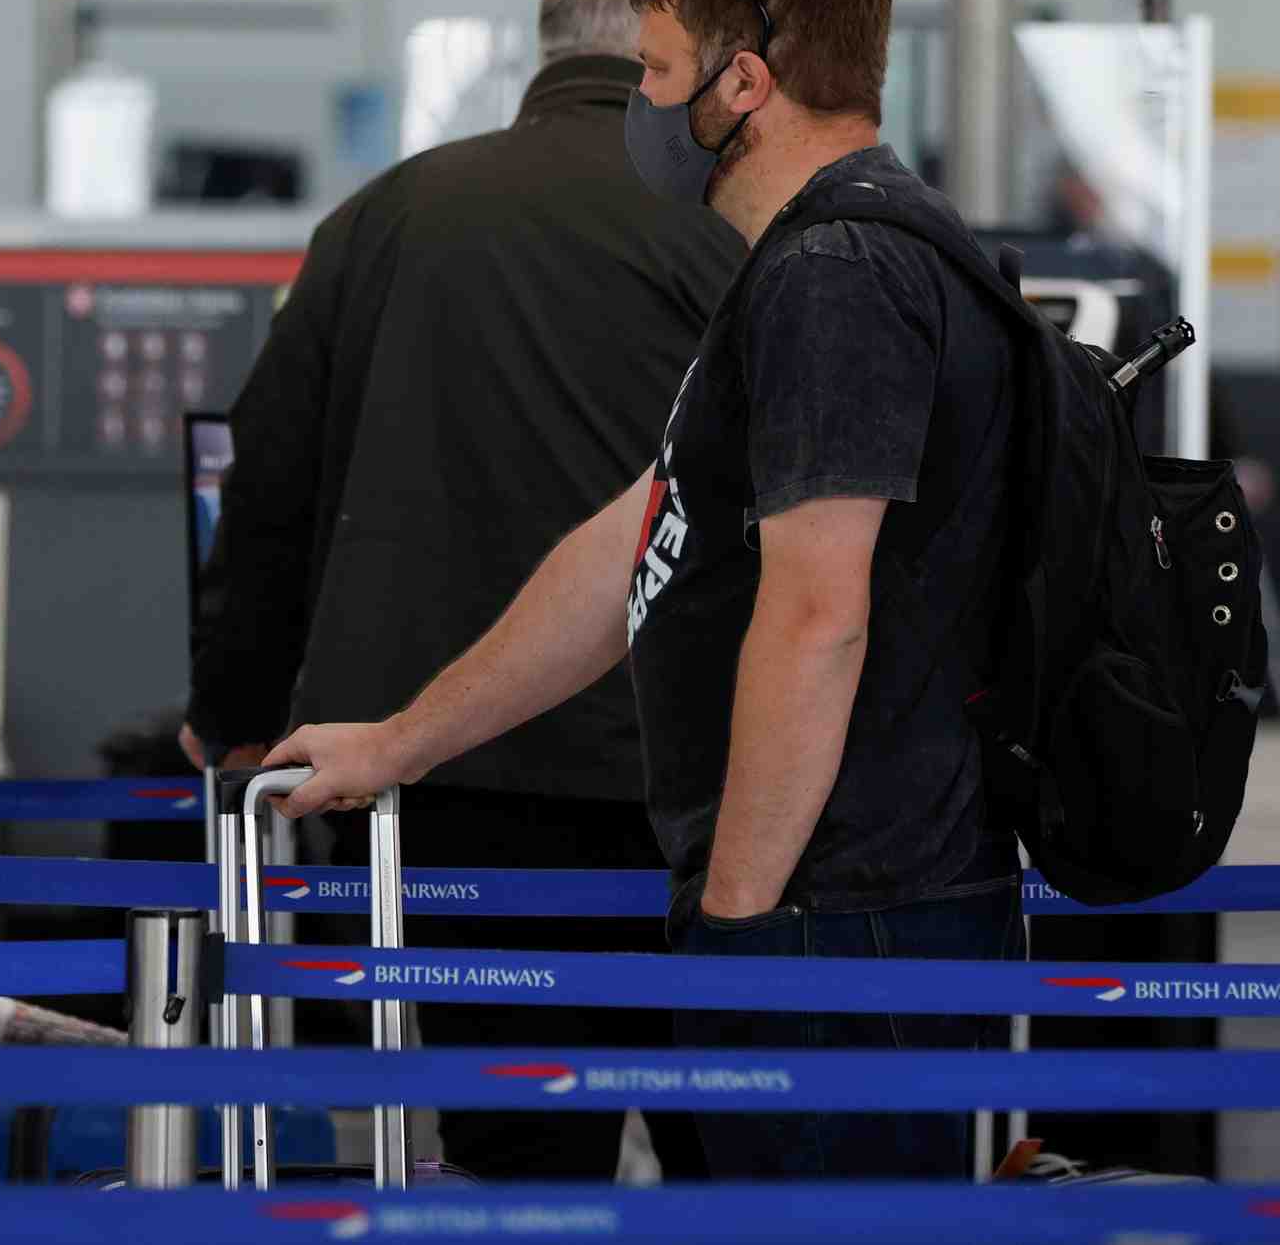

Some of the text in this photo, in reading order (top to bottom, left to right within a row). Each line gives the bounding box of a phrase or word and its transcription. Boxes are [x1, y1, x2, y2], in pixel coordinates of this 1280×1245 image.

[318, 881, 480, 900] BRITI AIRWAYS
[374, 965, 556, 988] BRITISH AIRWAYS
[1135, 981, 1220, 1000] BRITISH
[585, 1068, 793, 1092] BRITISH AIRWAYS
